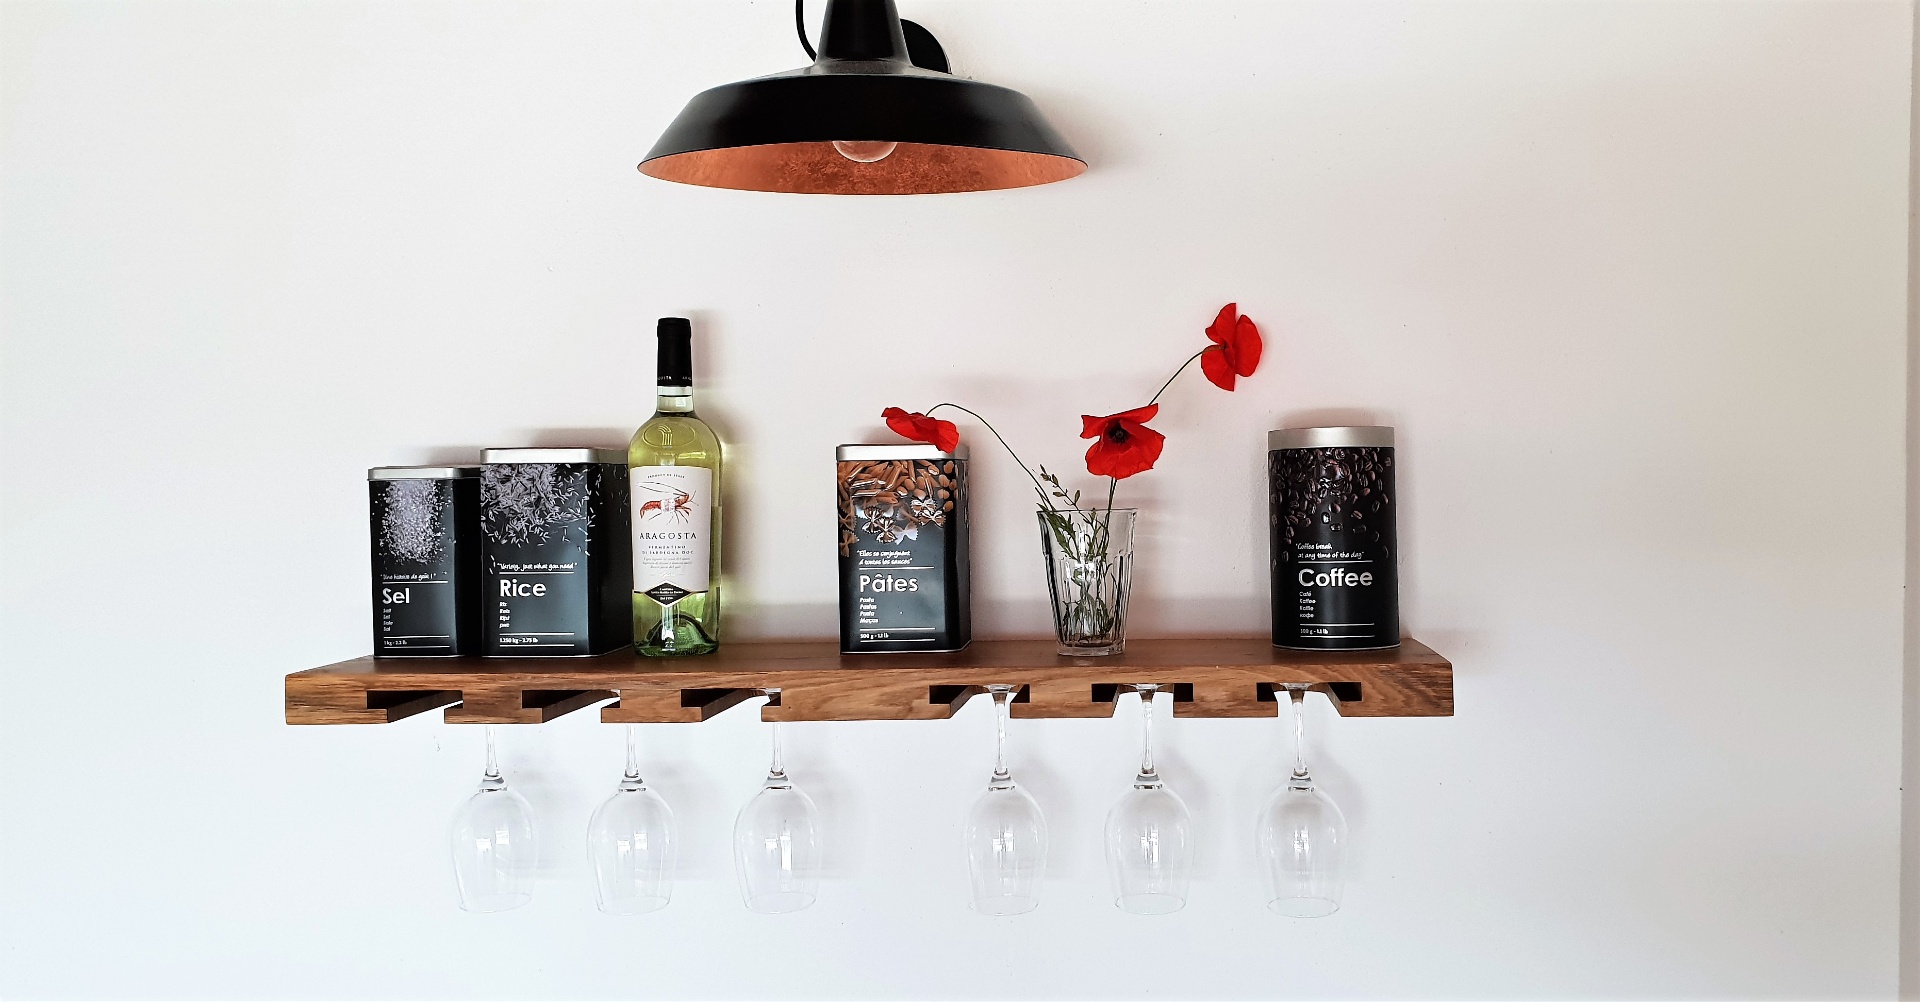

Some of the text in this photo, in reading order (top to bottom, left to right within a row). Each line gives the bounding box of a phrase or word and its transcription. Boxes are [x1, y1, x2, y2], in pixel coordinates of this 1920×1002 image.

[859, 573, 919, 592] Pâtes
[1298, 568, 1373, 587] Coffee
[382, 588, 410, 604] Sel
[500, 579, 546, 597] Rice
